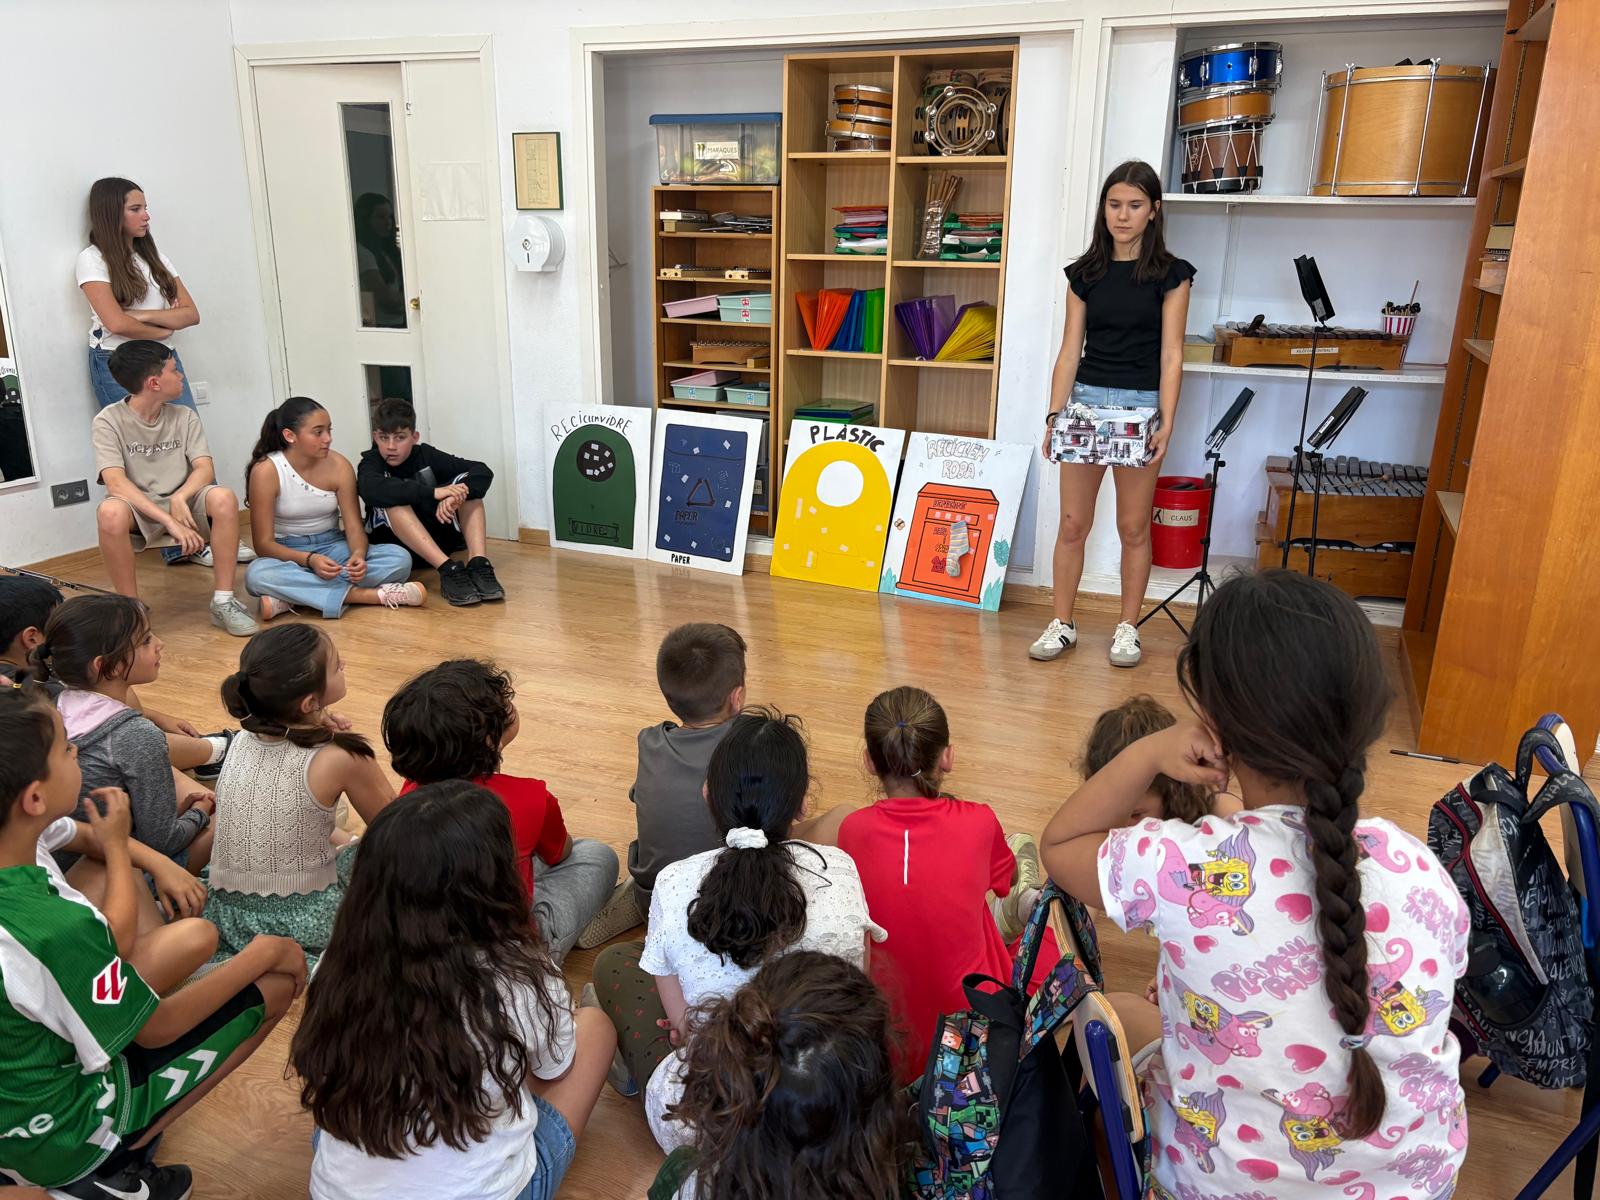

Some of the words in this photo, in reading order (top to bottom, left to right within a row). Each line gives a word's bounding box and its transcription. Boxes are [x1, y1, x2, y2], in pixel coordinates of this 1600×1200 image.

[942, 459, 976, 480] ROBA
[1170, 513, 1193, 522] CLAUS
[671, 553, 691, 565] PAPER
